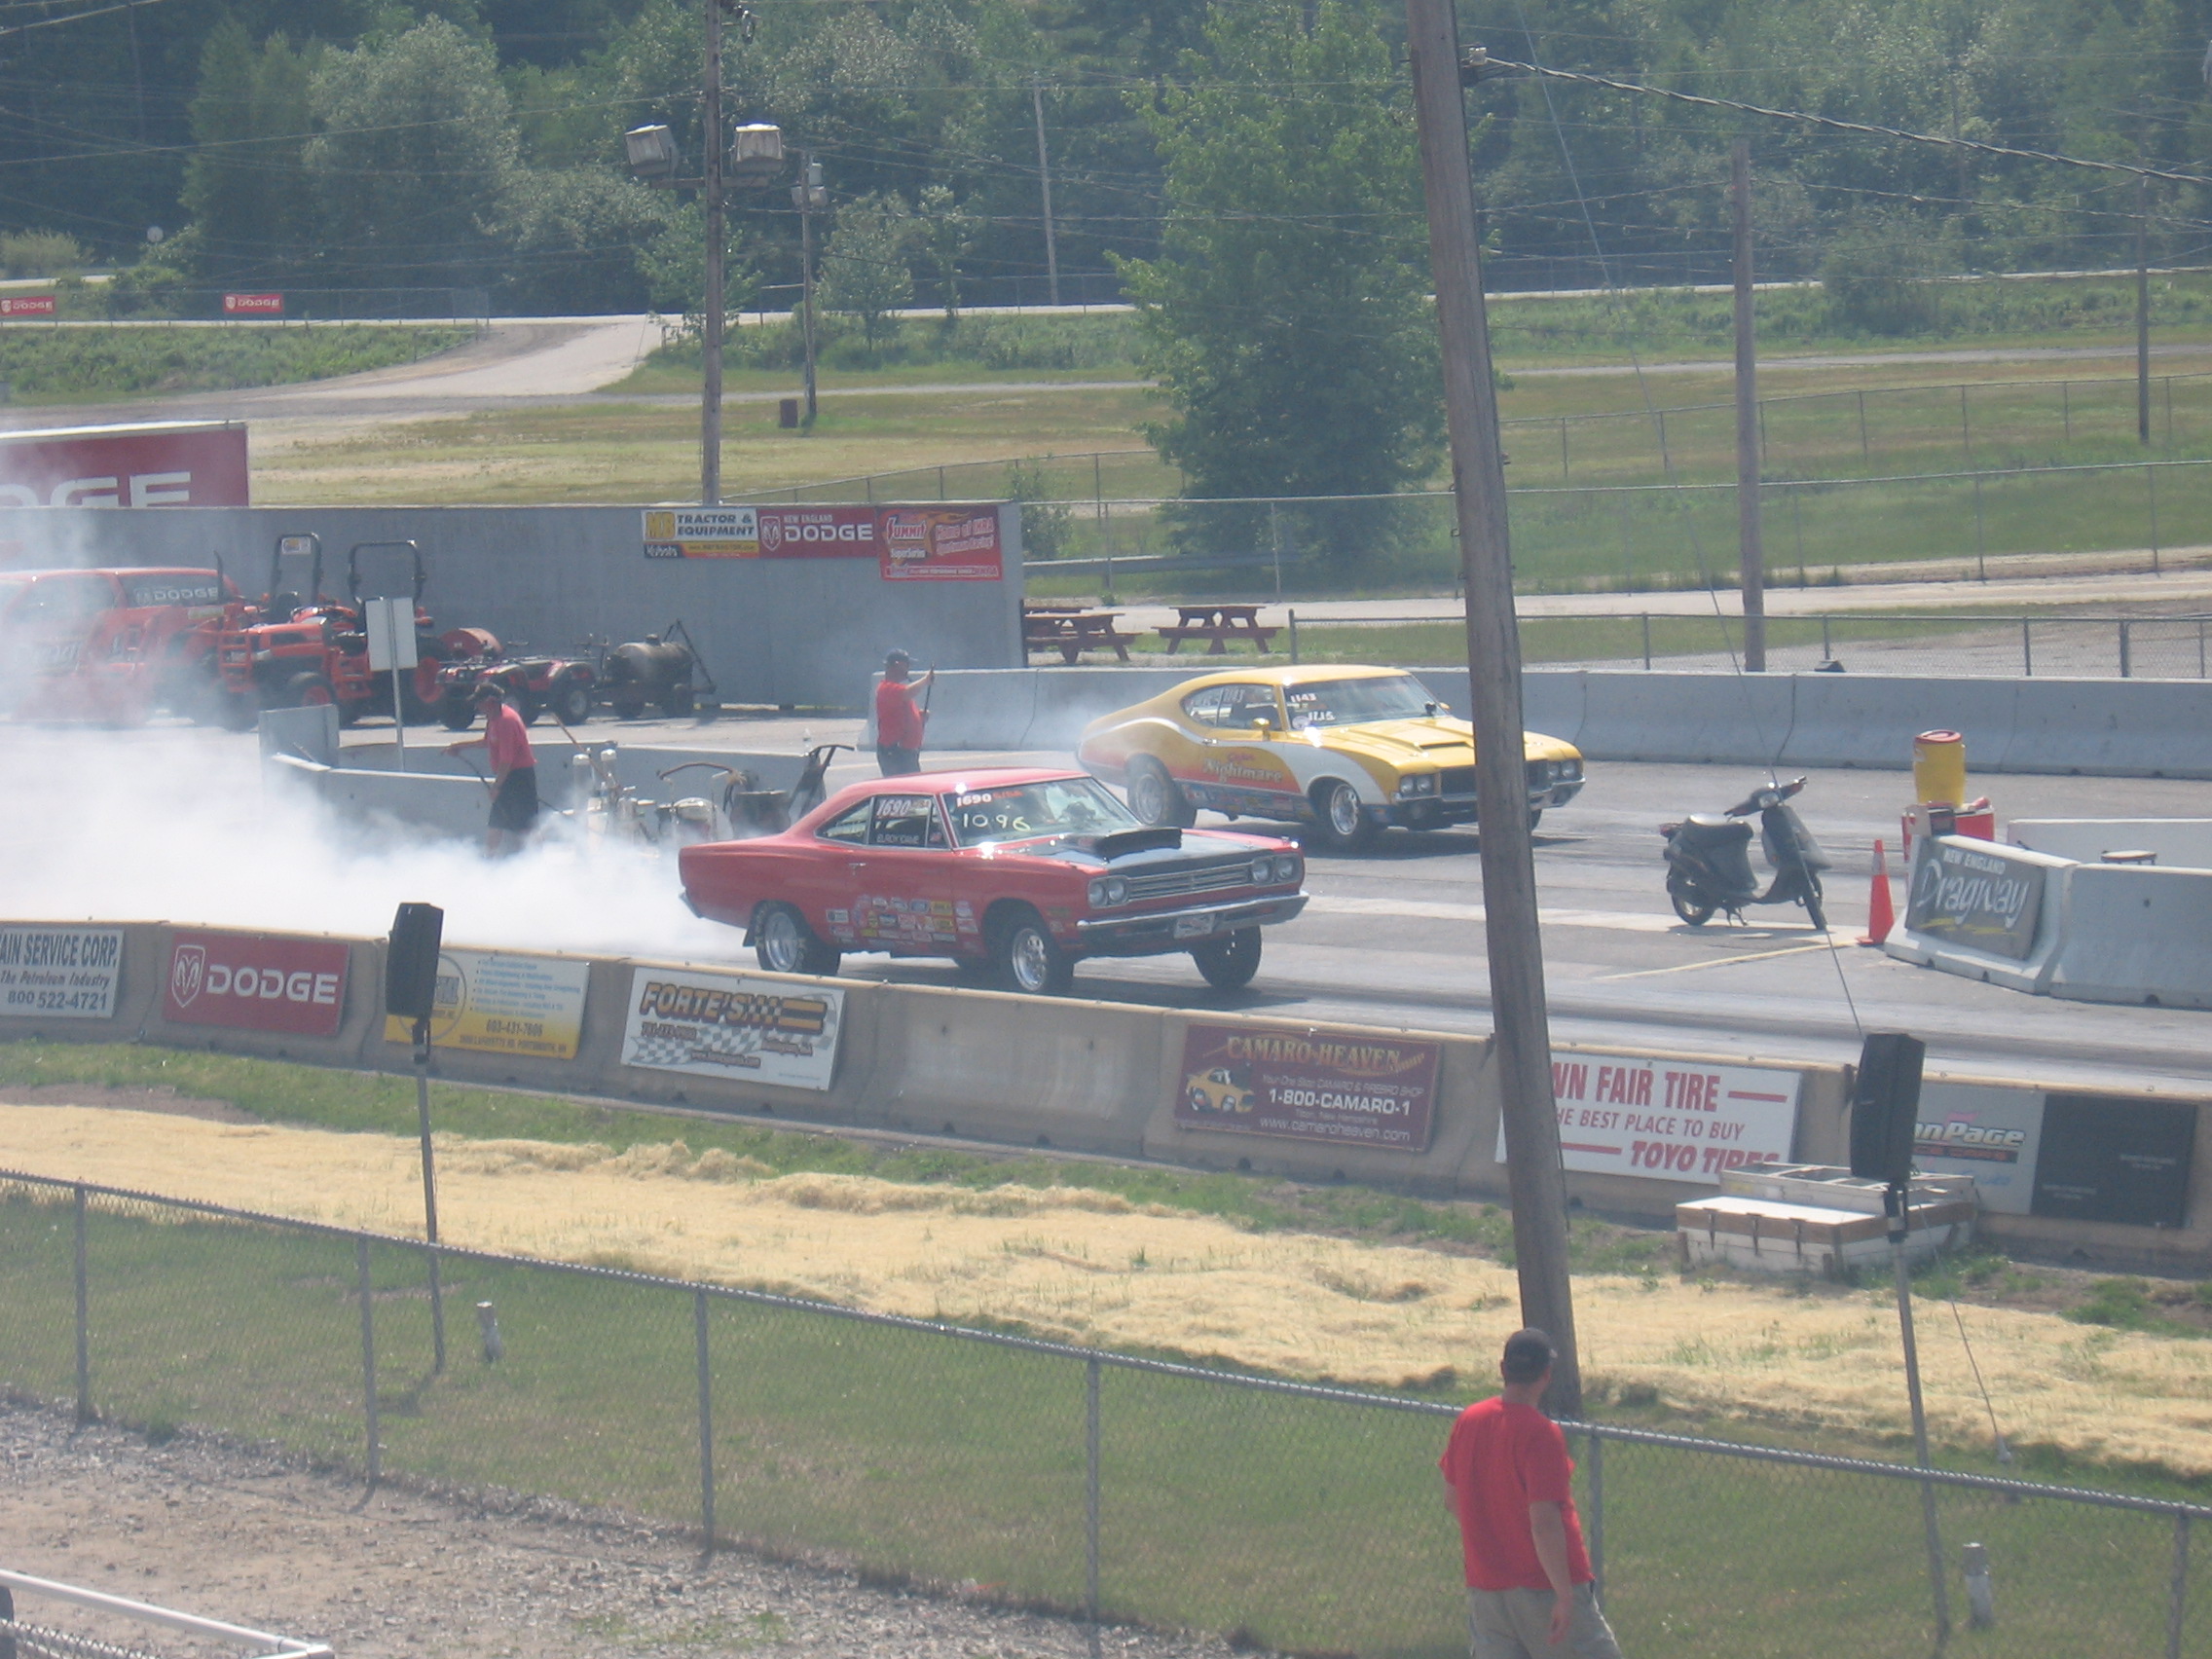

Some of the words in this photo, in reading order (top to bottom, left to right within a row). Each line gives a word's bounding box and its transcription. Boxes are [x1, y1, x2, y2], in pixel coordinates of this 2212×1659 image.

[678, 514, 736, 524] TRACTOR
[742, 514, 752, 524] &
[678, 526, 755, 535] EQUIPMENT
[784, 514, 799, 523] NEW
[801, 514, 833, 523] ENGLAND
[784, 524, 873, 541] DODGE
[154, 587, 218, 601] DODGE
[1290, 692, 1317, 703] 1143
[1203, 757, 1283, 783] Nightmare
[877, 798, 912, 817] 1690
[956, 793, 992, 808] 1690
[1943, 847, 1964, 865] NEW
[1965, 852, 2006, 875] ENGLAND
[1916, 858, 2030, 929] Dragway
[24, 934, 79, 966] SERVICE
[82, 935, 117, 968] CORP.
[20, 970, 66, 985] Petroleum
[69, 971, 111, 991] Industry
[205, 964, 339, 1004] DODGE
[8, 989, 35, 1005] 800
[37, 991, 107, 1011] 522-4721
[640, 981, 754, 1024] FORTE'S
[1228, 1035, 1312, 1063] CAMARO
[1318, 1042, 1401, 1071] HEAVEN
[1596, 1066, 1654, 1106] FAIR
[1665, 1071, 1721, 1112] TIRE
[1269, 1088, 1411, 1116] 1-800-CAMARO-1
[1260, 1117, 1411, 1142] www.camaroheaven.com
[1557, 1108, 1575, 1125] HE
[1579, 1109, 1620, 1129] BEST
[1624, 1114, 1677, 1135] PLACE
[1683, 1119, 1704, 1137] TO
[1709, 1122, 1745, 1141] BUY
[1631, 1140, 1697, 1172] TOYO
